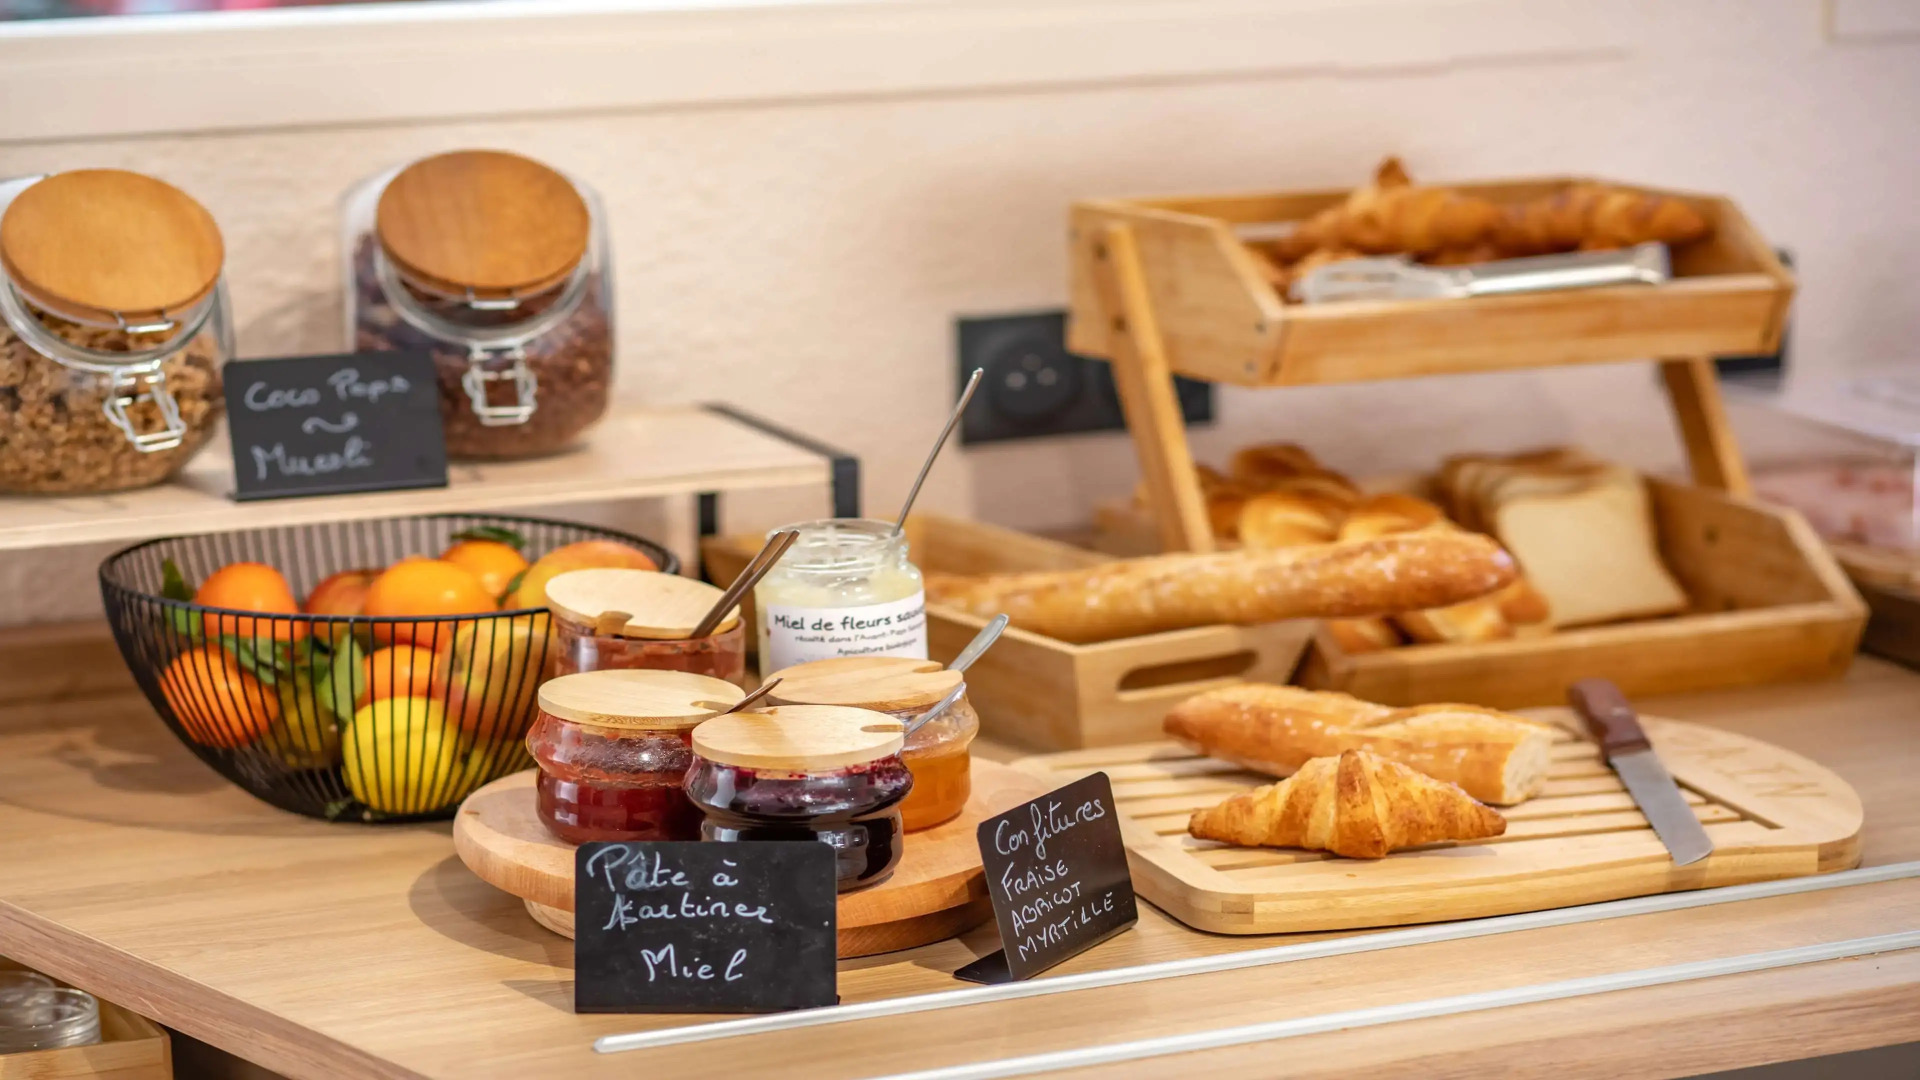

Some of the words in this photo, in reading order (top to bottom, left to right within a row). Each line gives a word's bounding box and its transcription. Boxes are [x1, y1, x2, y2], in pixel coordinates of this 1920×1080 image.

[244, 381, 321, 411] Coco
[775, 614, 805, 630] Miel
[811, 617, 835, 631] de
[840, 615, 891, 630] fleurs
[995, 798, 1106, 860] Confitures
[586, 843, 690, 892] Pâte
[712, 859, 739, 886] à
[641, 943, 748, 982] Miel
